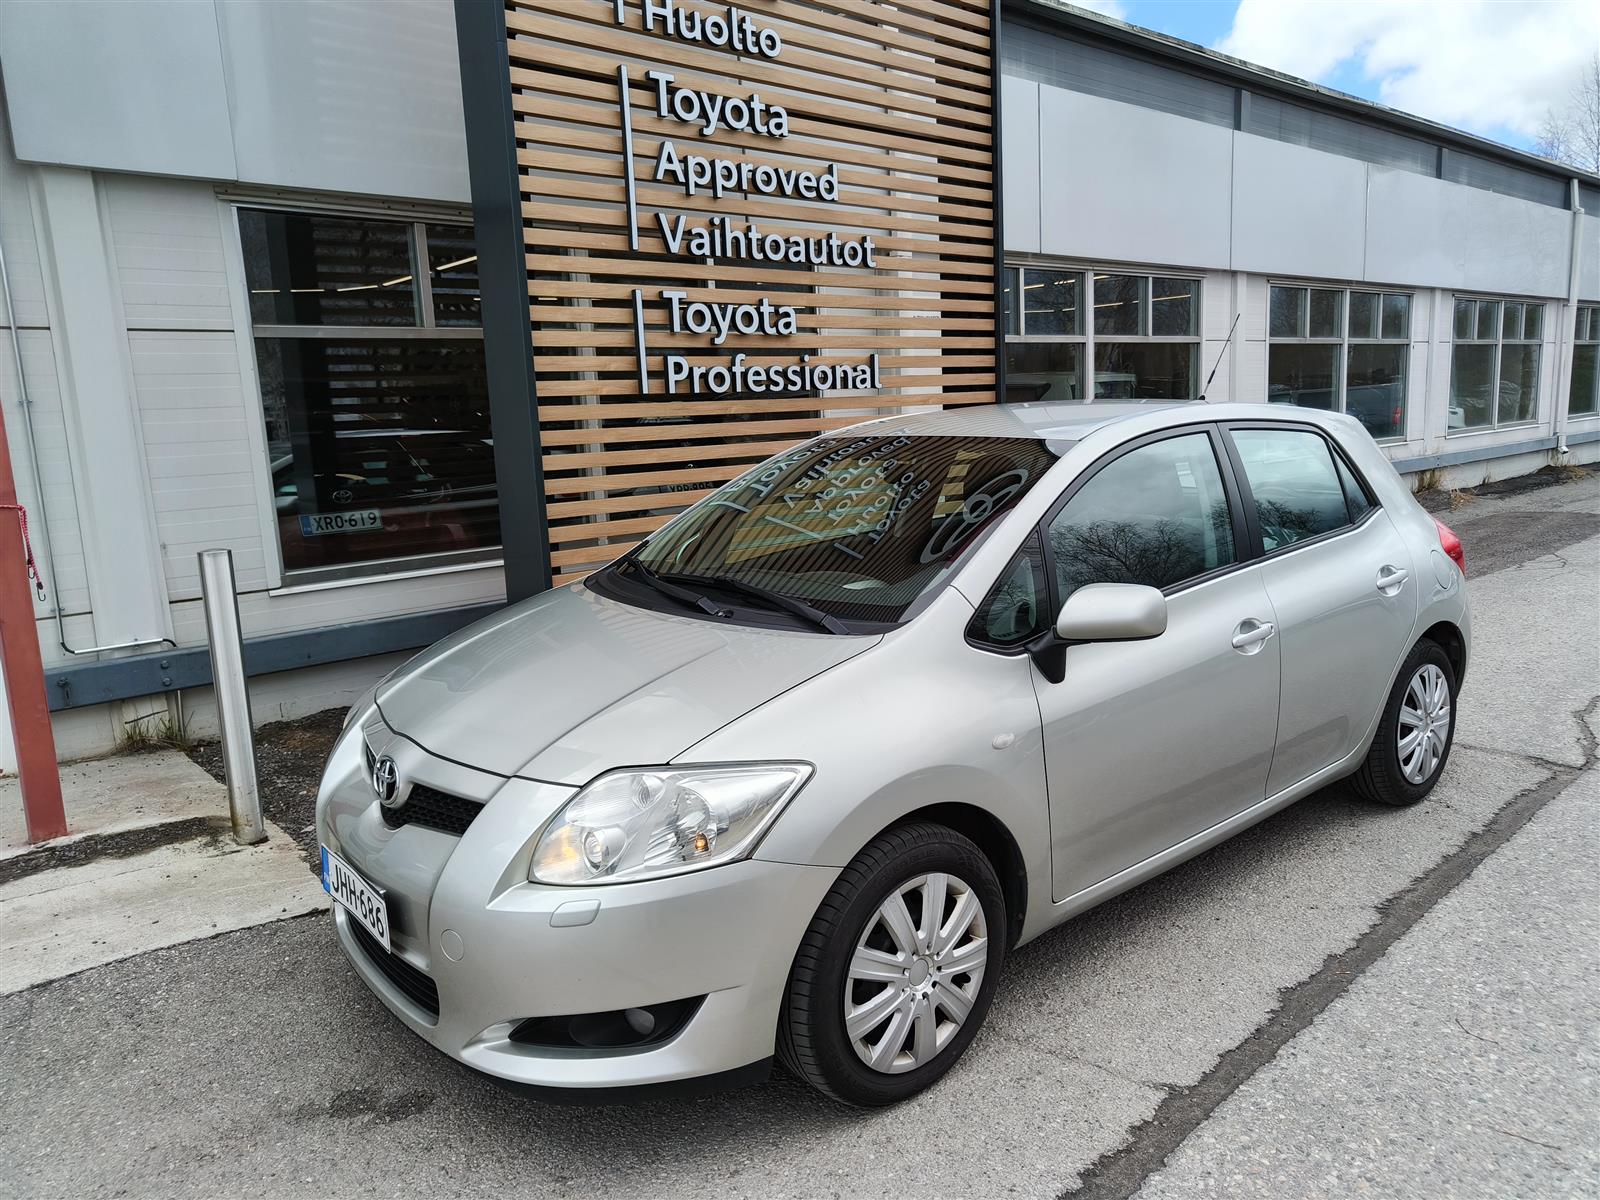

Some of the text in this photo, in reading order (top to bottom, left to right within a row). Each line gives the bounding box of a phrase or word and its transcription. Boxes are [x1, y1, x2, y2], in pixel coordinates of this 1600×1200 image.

[642, 0, 782, 58] Huolto
[646, 70, 789, 138] Toyota
[655, 141, 839, 201] Approved
[656, 212, 876, 268] Vaihtoautot
[659, 290, 798, 345] Toyota
[664, 353, 882, 394] Professional
[313, 511, 378, 531] XRO-619
[332, 864, 385, 938] JHH-686
